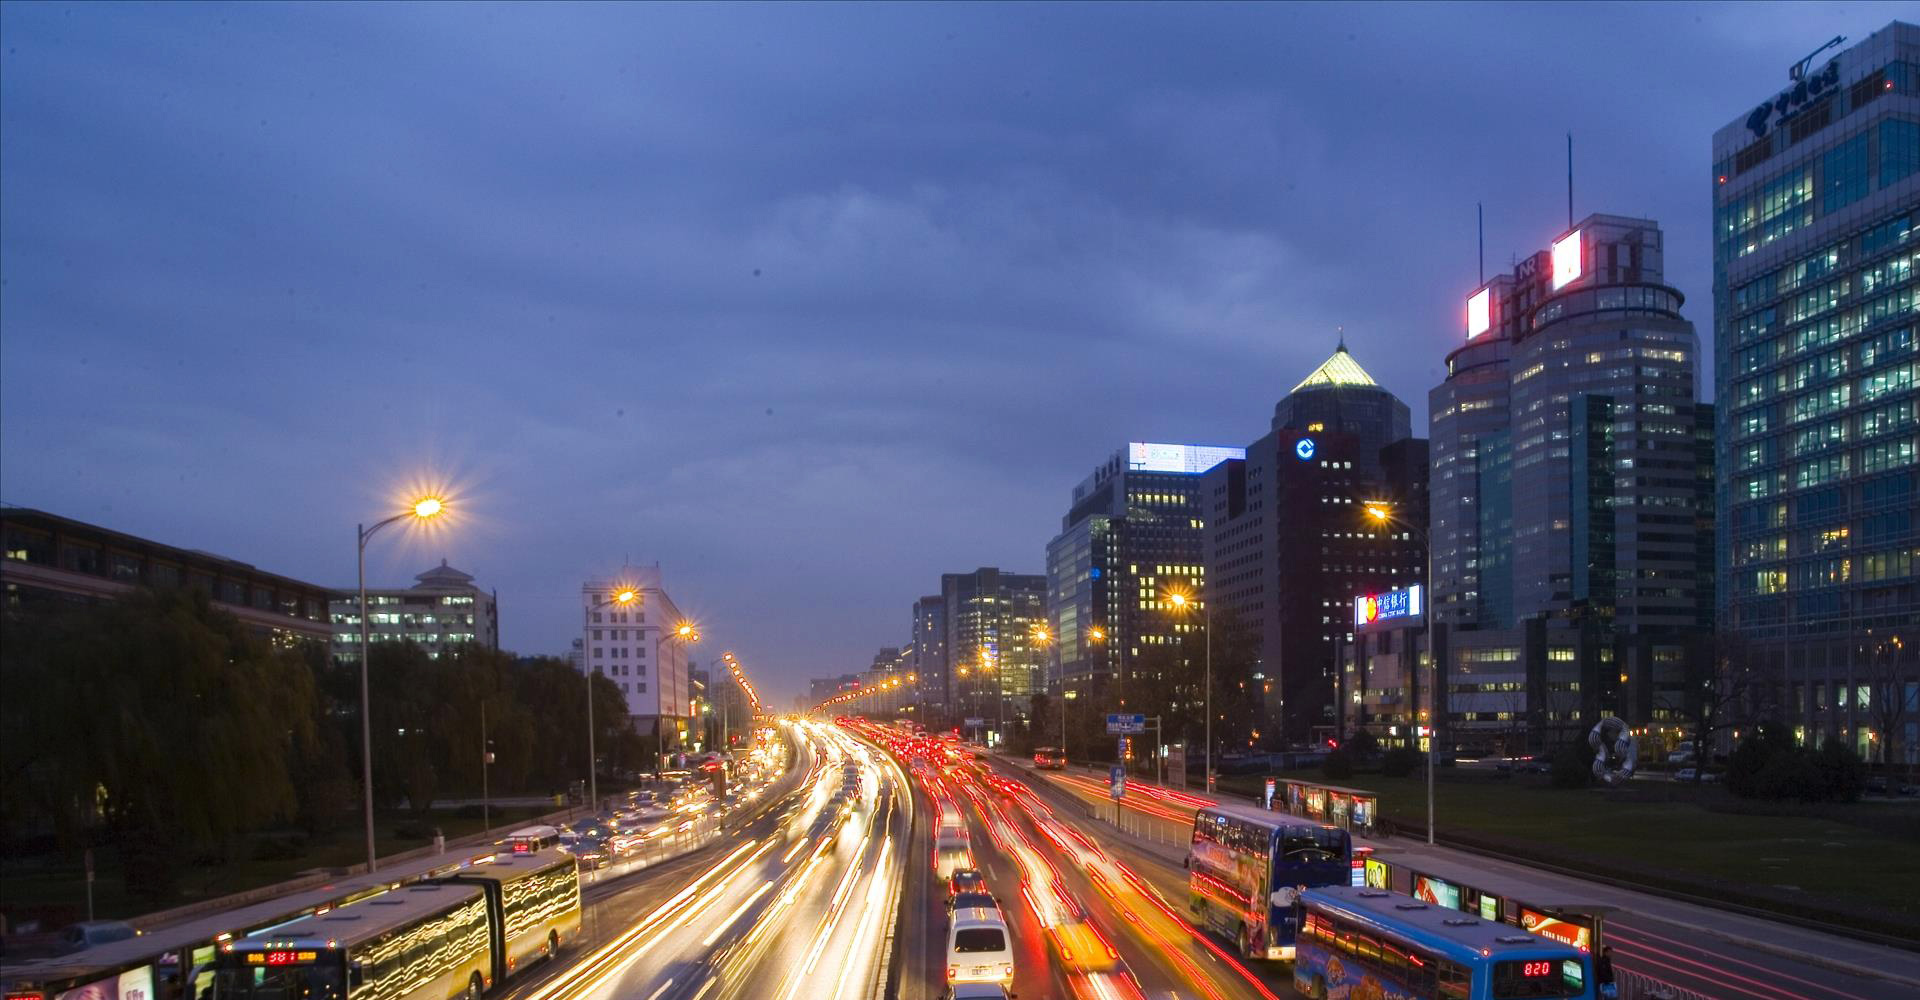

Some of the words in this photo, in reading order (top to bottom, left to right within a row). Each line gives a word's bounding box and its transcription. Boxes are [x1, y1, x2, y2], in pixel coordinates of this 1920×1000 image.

[1378, 592, 1408, 612] 中信银行
[1525, 962, 1550, 975] 820
